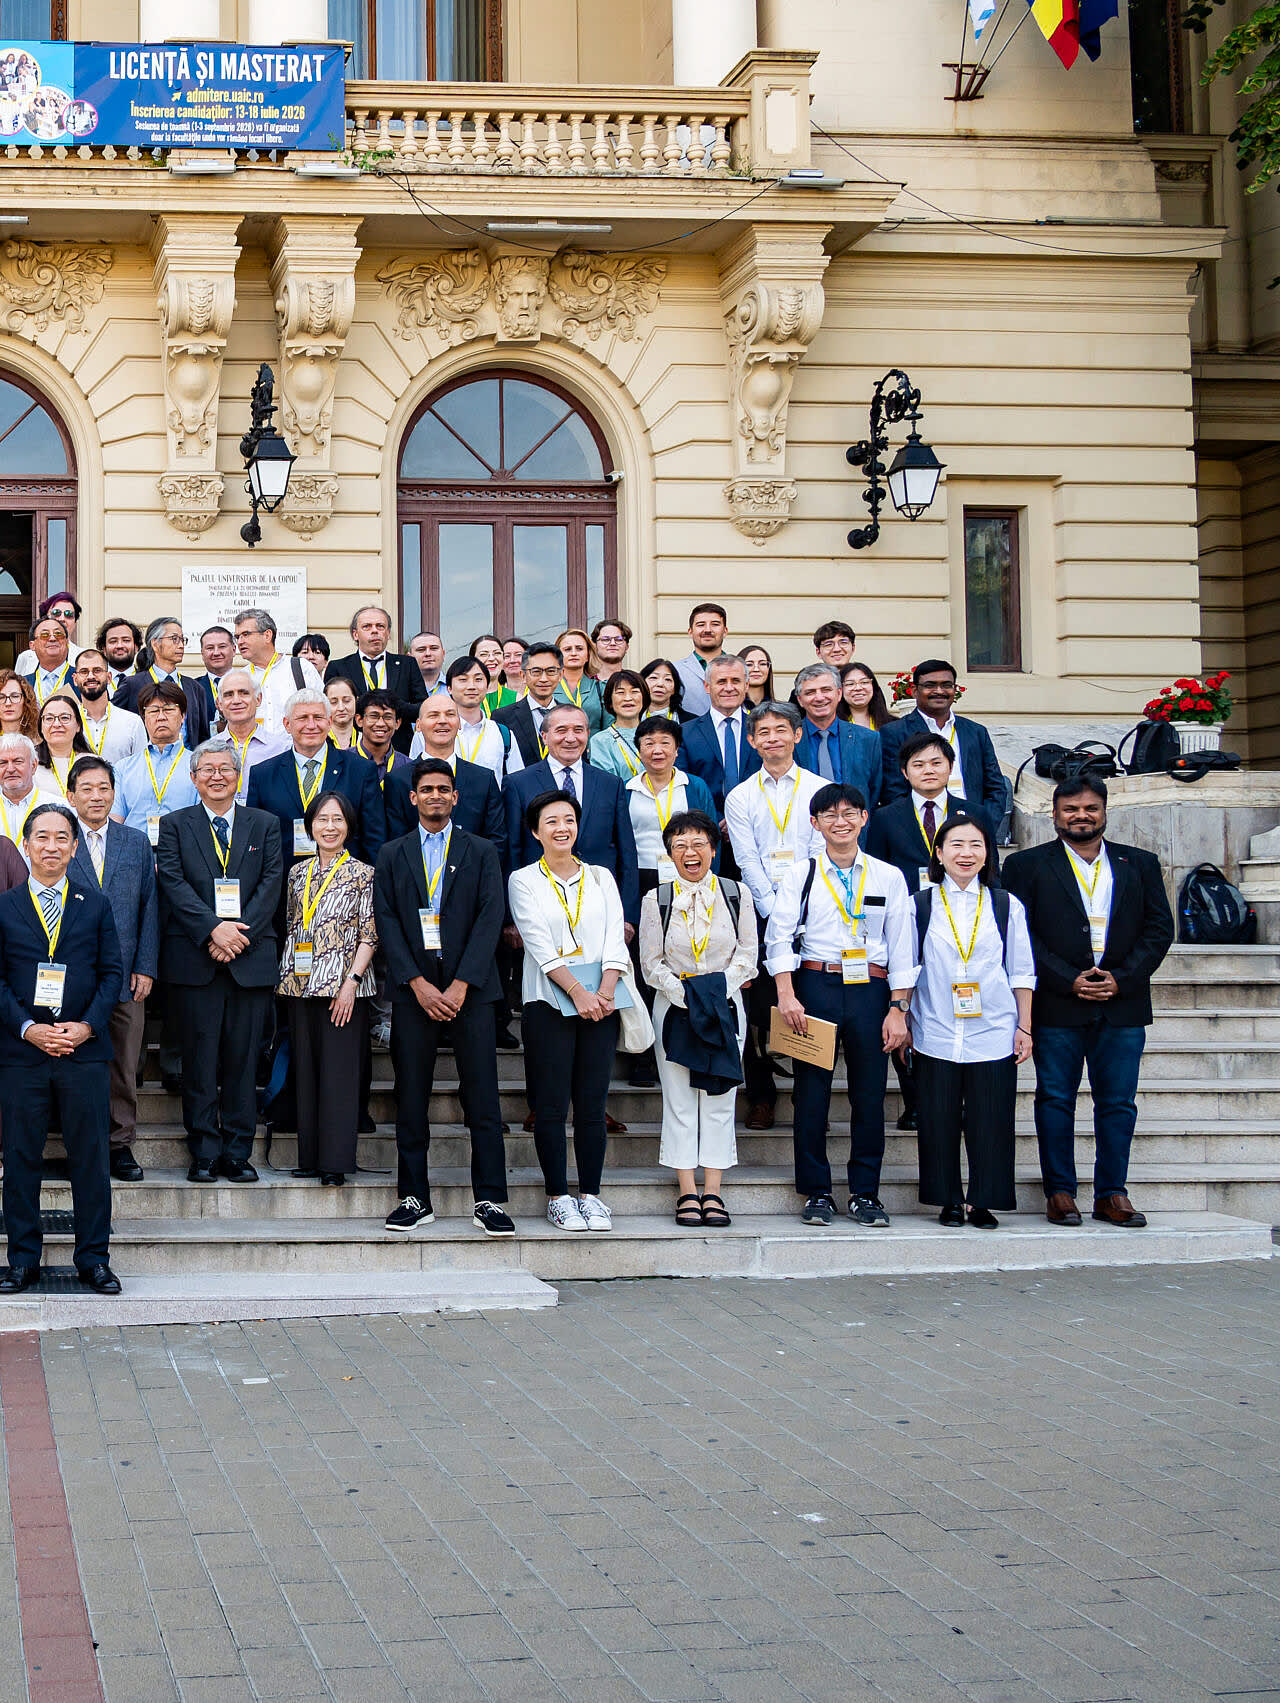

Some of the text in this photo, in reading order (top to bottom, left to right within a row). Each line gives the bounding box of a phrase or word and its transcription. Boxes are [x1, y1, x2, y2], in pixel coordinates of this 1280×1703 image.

[109, 47, 325, 88] LICENȚĂ ȘI MASTERAT
[186, 87, 264, 103] admitere.uaic.ro
[130, 100, 306, 122] Înscrierea candidaților: 13-18 iulie 2026
[218, 574, 257, 583] UNIVERSITAR
[260, 575, 266, 583] DE
[269, 575, 276, 583] LA
[278, 574, 298, 583] COPOU
